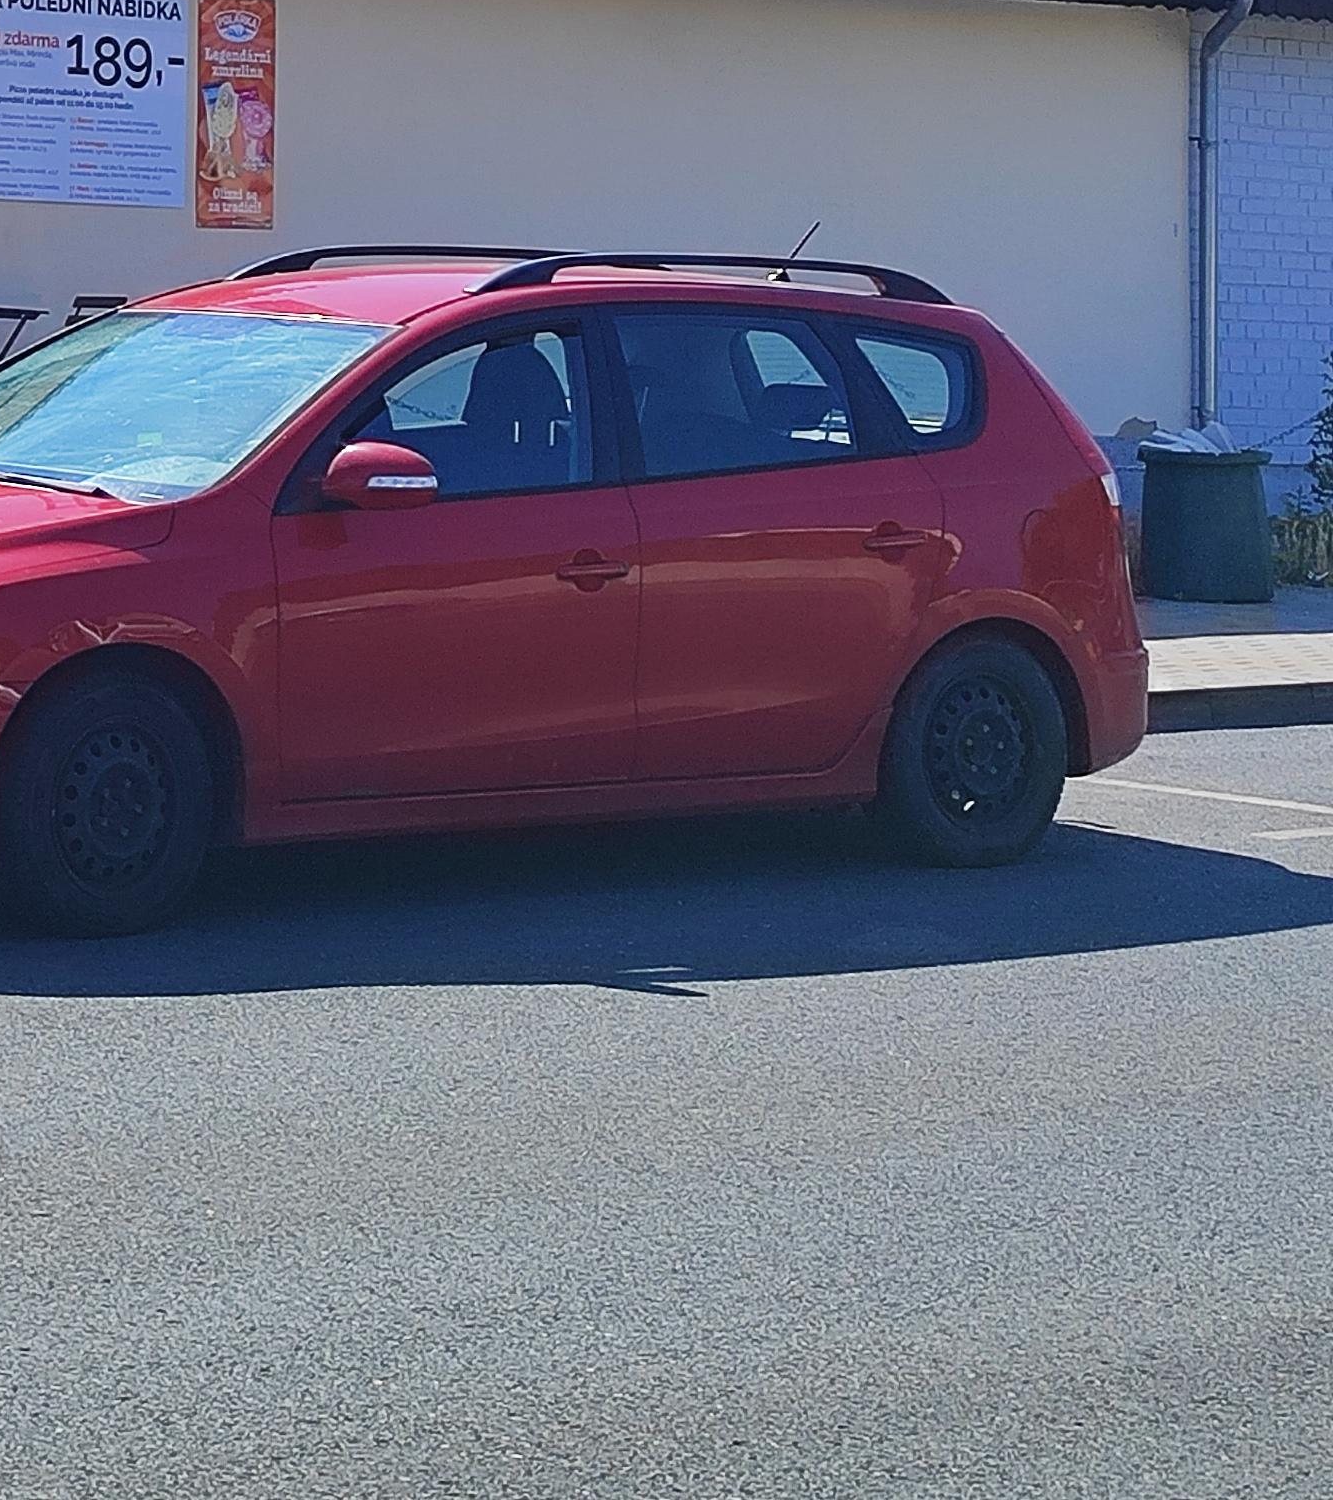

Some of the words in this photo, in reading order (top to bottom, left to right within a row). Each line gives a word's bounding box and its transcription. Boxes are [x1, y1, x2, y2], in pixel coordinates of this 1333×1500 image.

[4, 30, 60, 49] zdarma
[66, 33, 185, 89] 189,-
[204, 47, 272, 65] Legendární
[212, 64, 264, 78] zmrzlina
